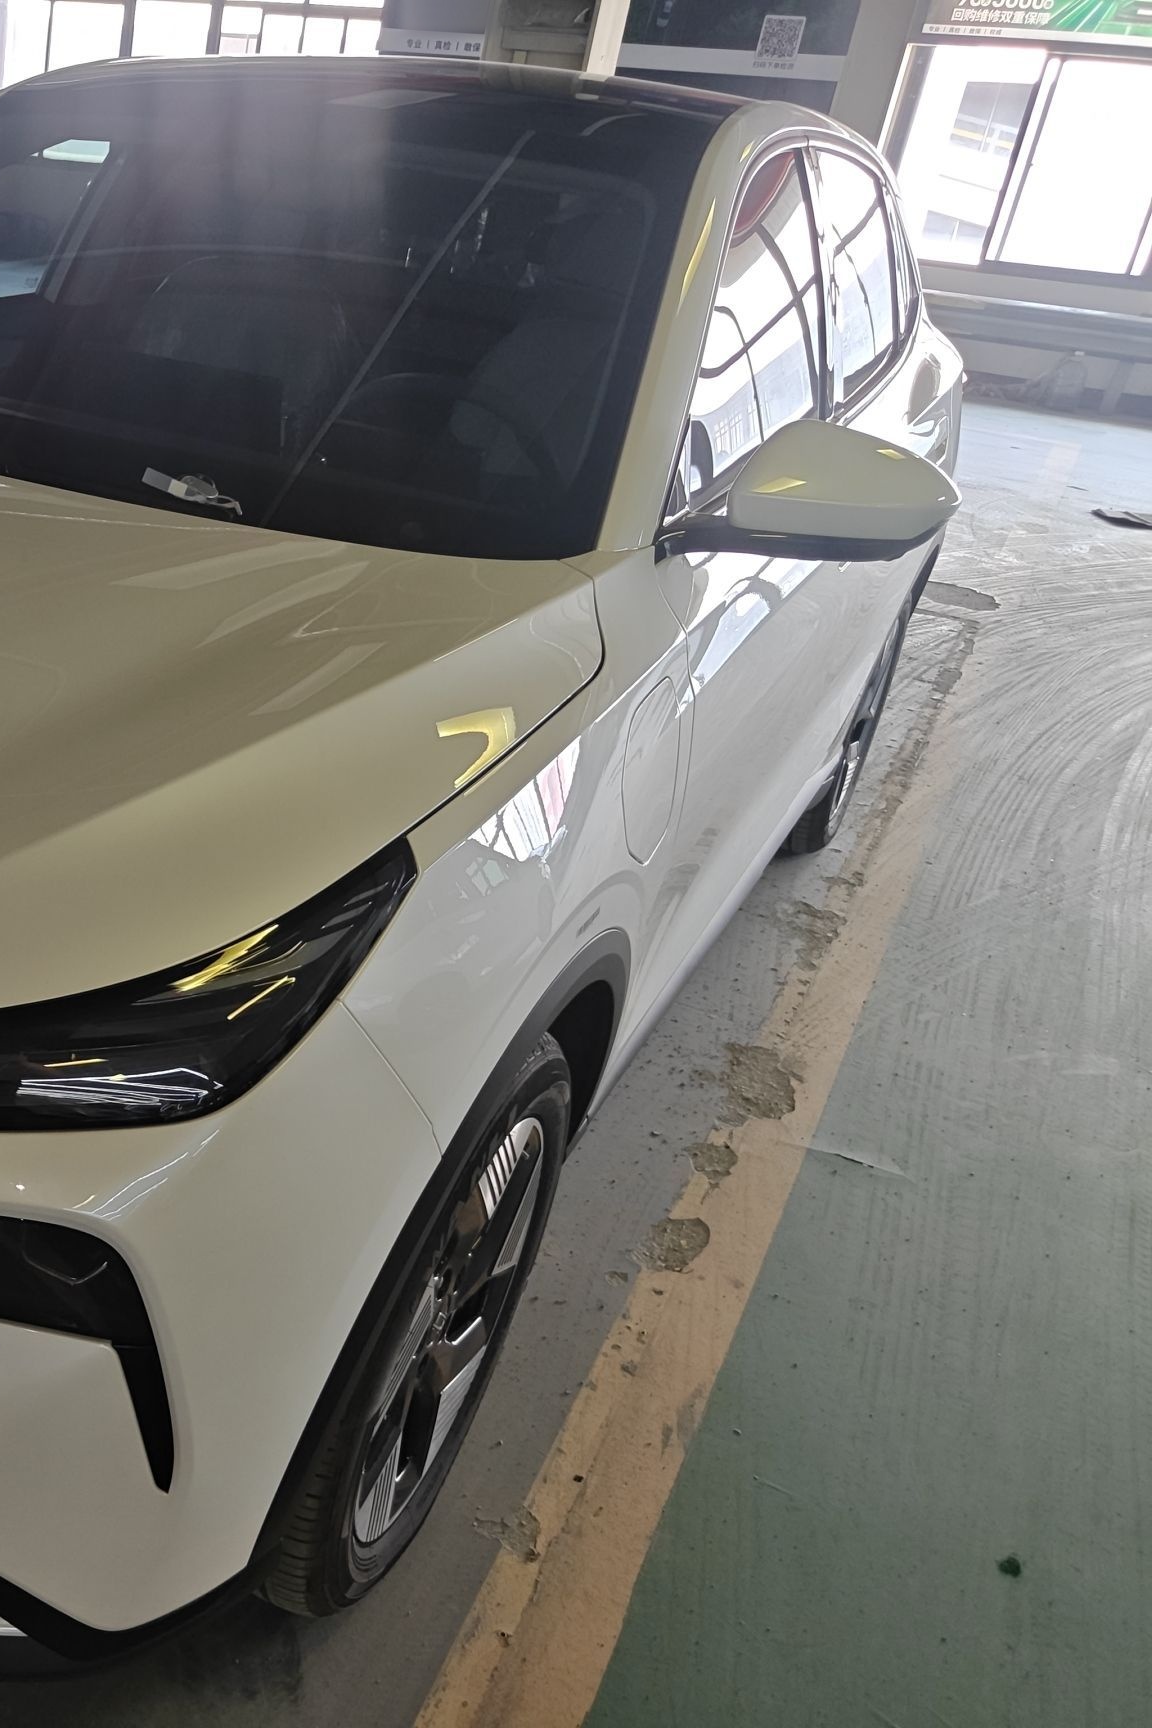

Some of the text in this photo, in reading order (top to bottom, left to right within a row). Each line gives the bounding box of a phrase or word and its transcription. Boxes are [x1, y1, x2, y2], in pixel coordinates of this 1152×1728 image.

[951, 8, 1051, 25] 回购维修双重保障
[407, 38, 422, 49] 专业
